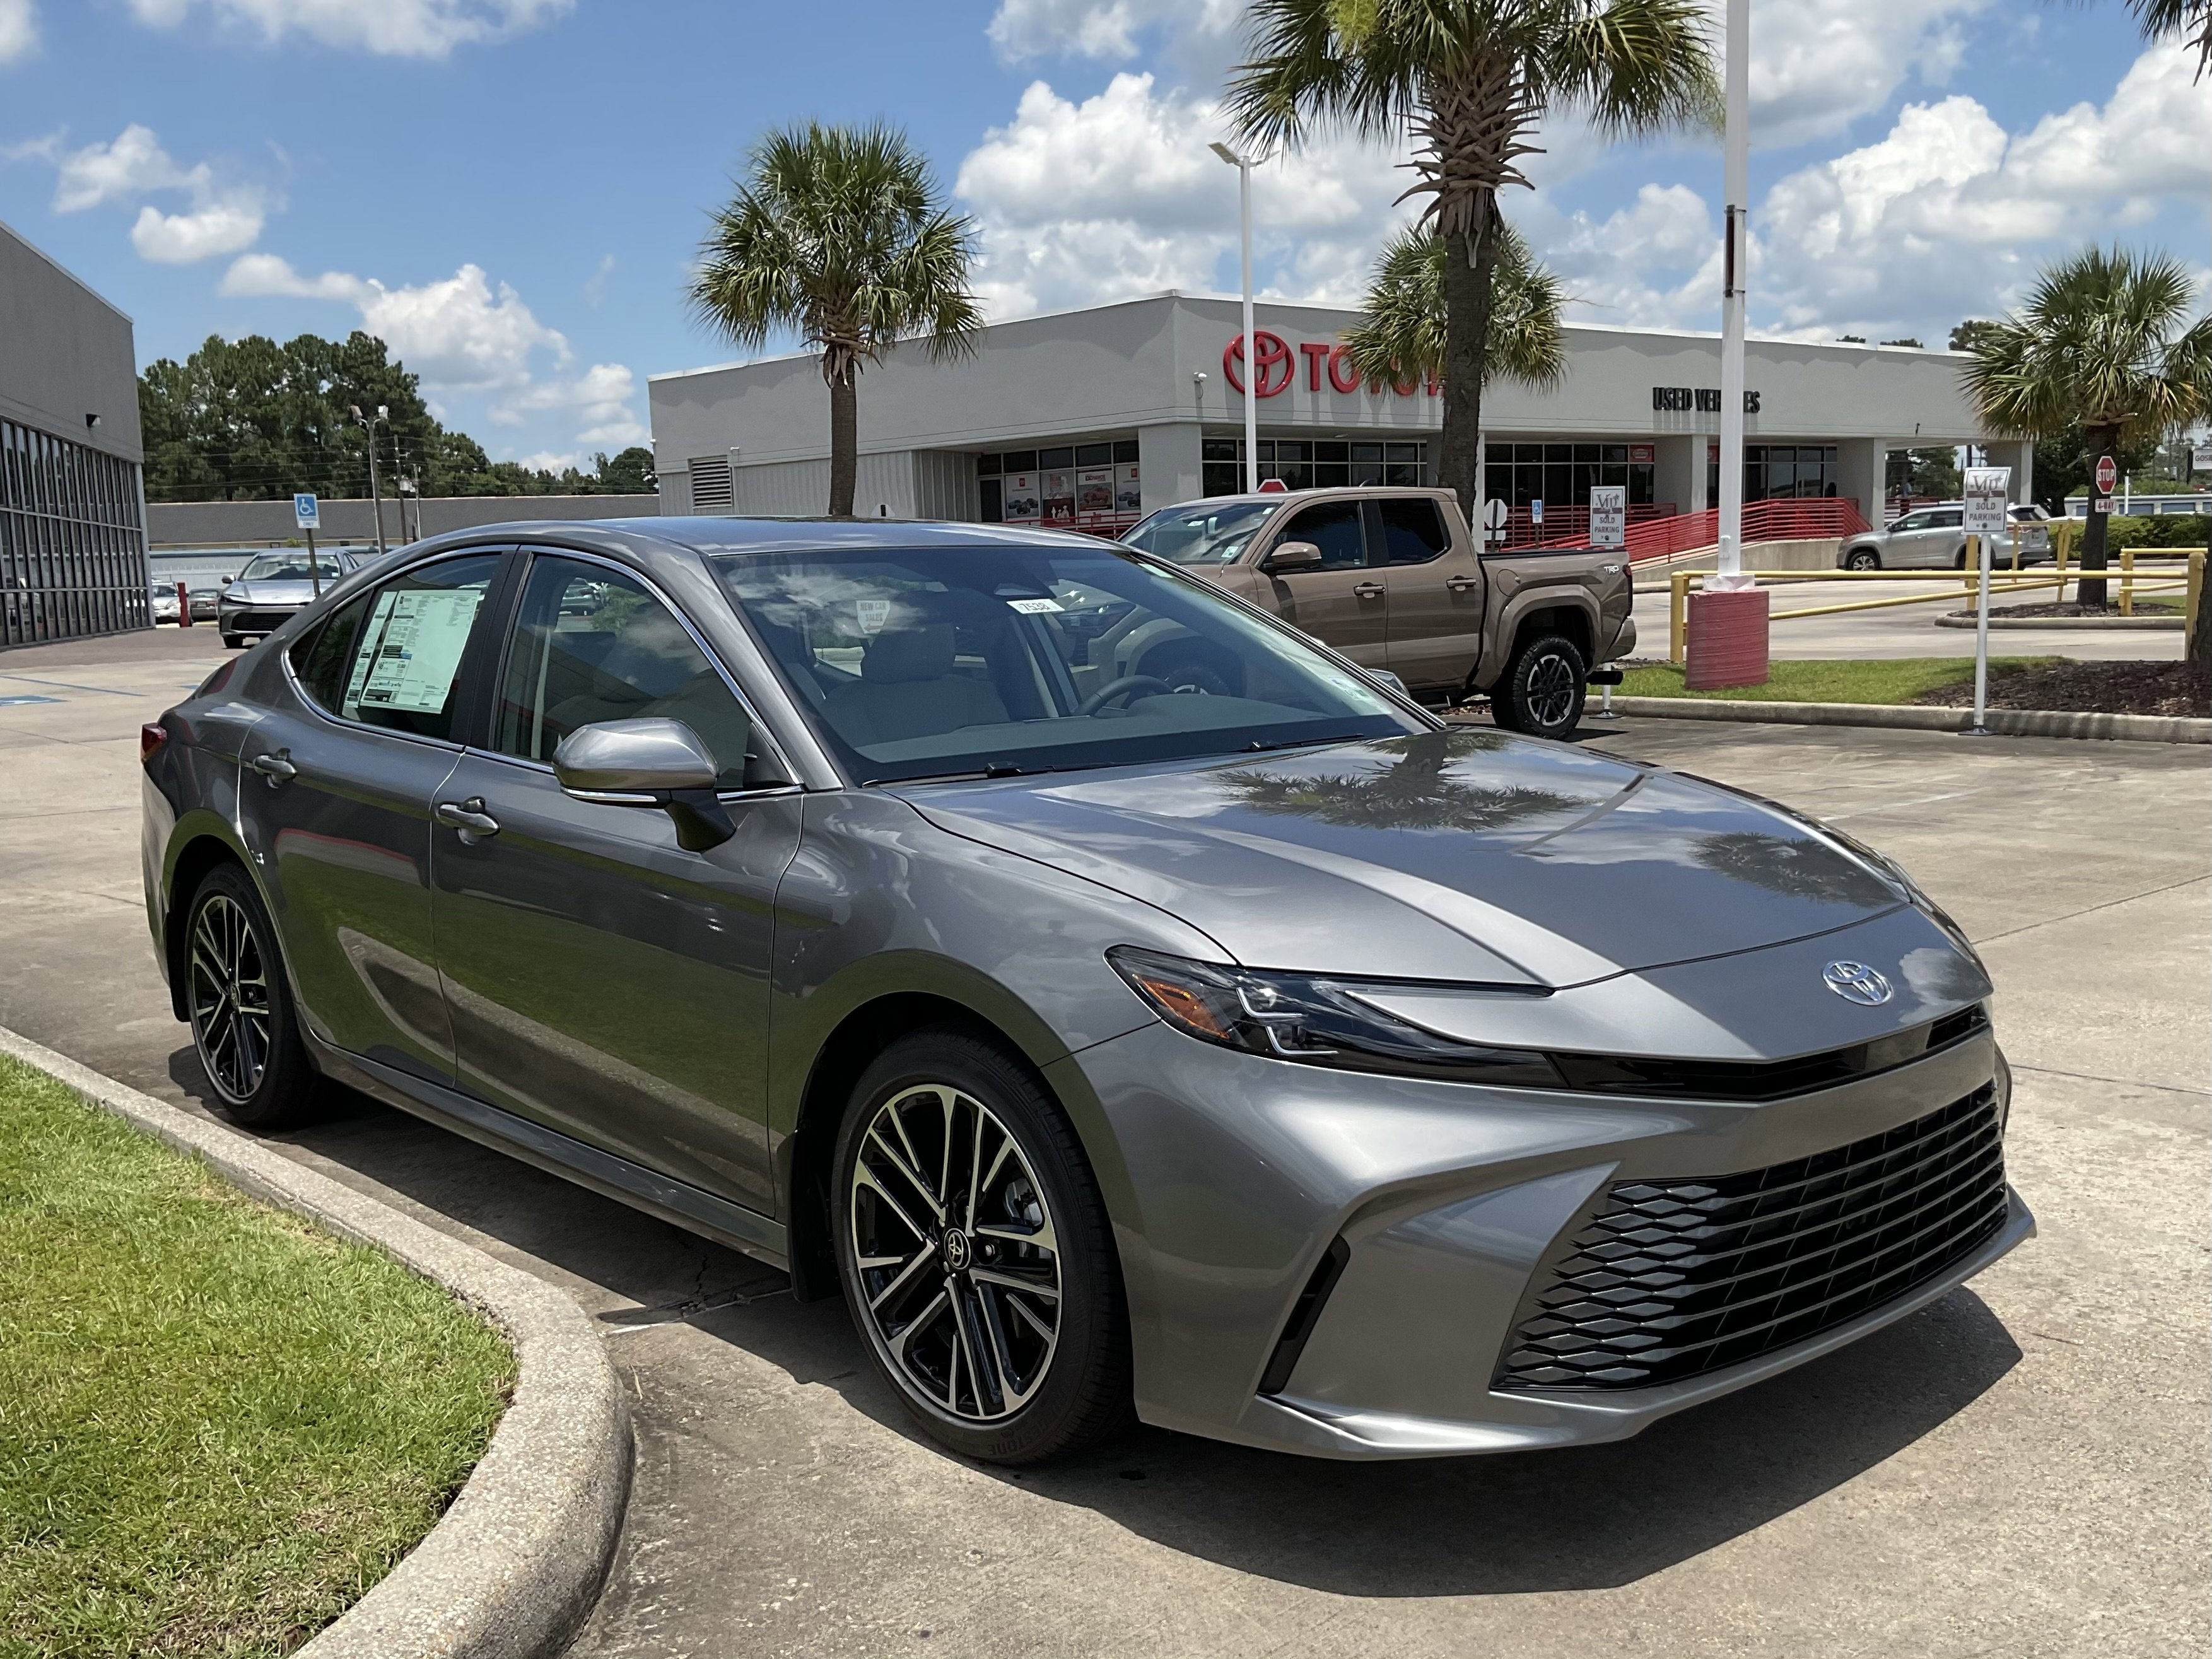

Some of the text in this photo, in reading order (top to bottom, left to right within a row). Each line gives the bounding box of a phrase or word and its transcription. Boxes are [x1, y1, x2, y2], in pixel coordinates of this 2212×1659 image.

[1653, 387, 1760, 413] USED VEHES
[2098, 469, 2115, 481] STOP
[1975, 502, 1996, 510] SOLD
[2098, 501, 2114, 510] 4-WAY
[1969, 513, 2001, 521] PARKING
[1603, 565, 1619, 574] TRD
[860, 602, 887, 611] NEW CAR
[865, 613, 883, 622] SALES
